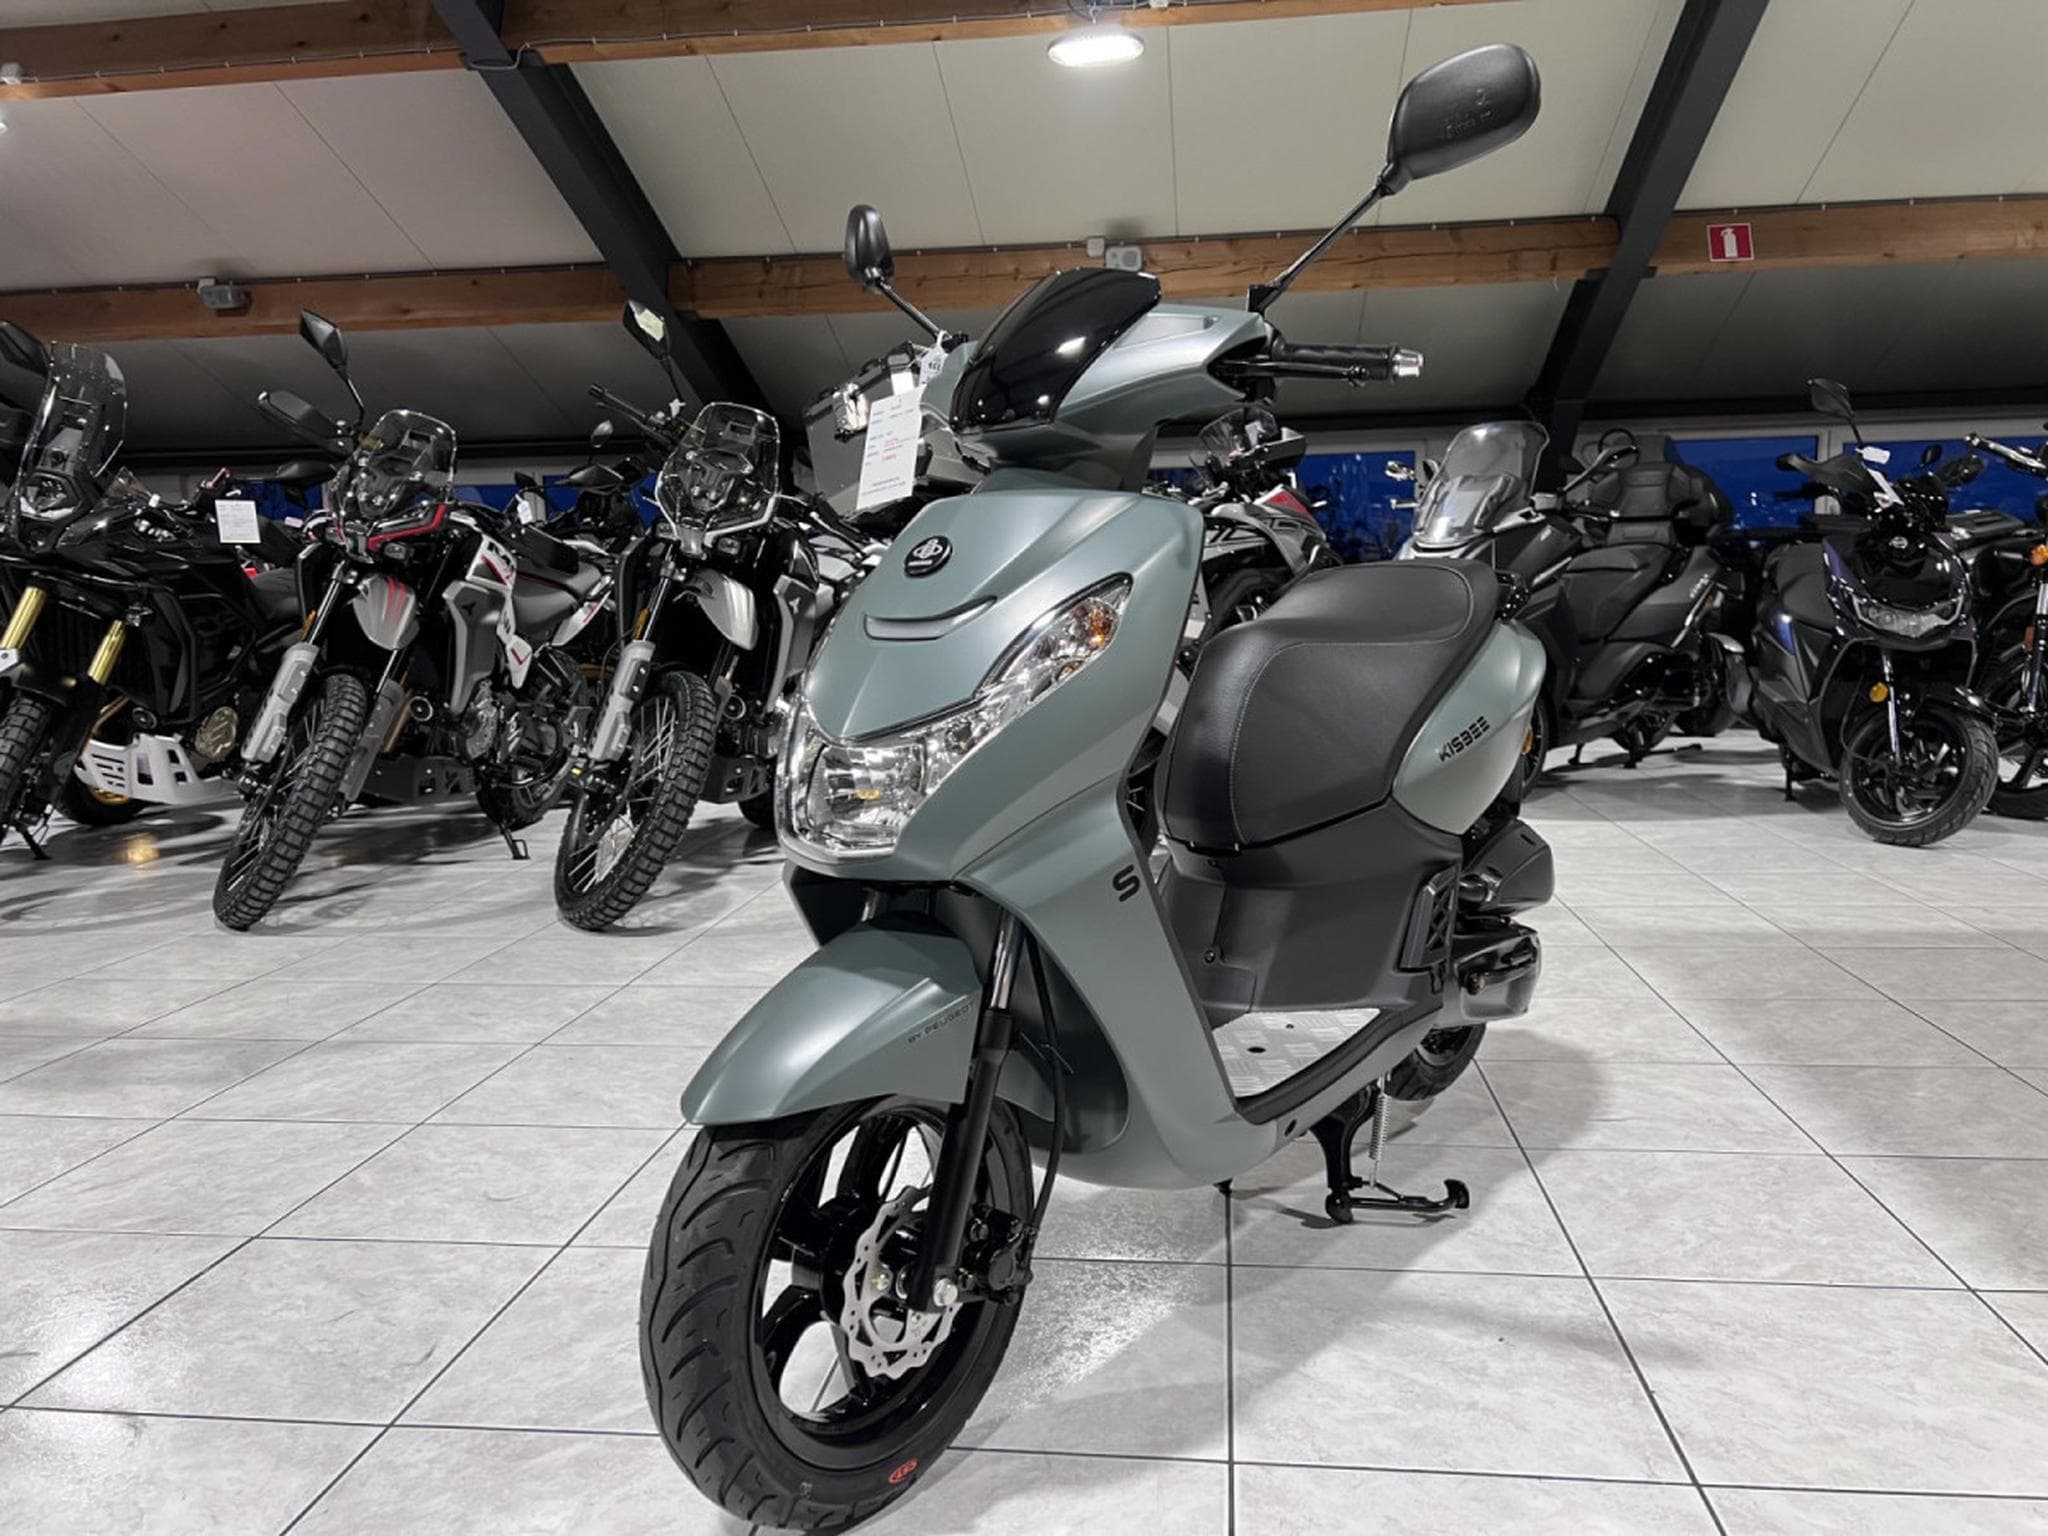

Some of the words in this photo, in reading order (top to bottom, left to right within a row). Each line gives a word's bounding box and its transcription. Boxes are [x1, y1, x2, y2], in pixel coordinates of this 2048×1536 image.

[1112, 864, 1140, 902] S
[907, 1033, 922, 1044] BY
[924, 1000, 975, 1034] PEUGEOT
